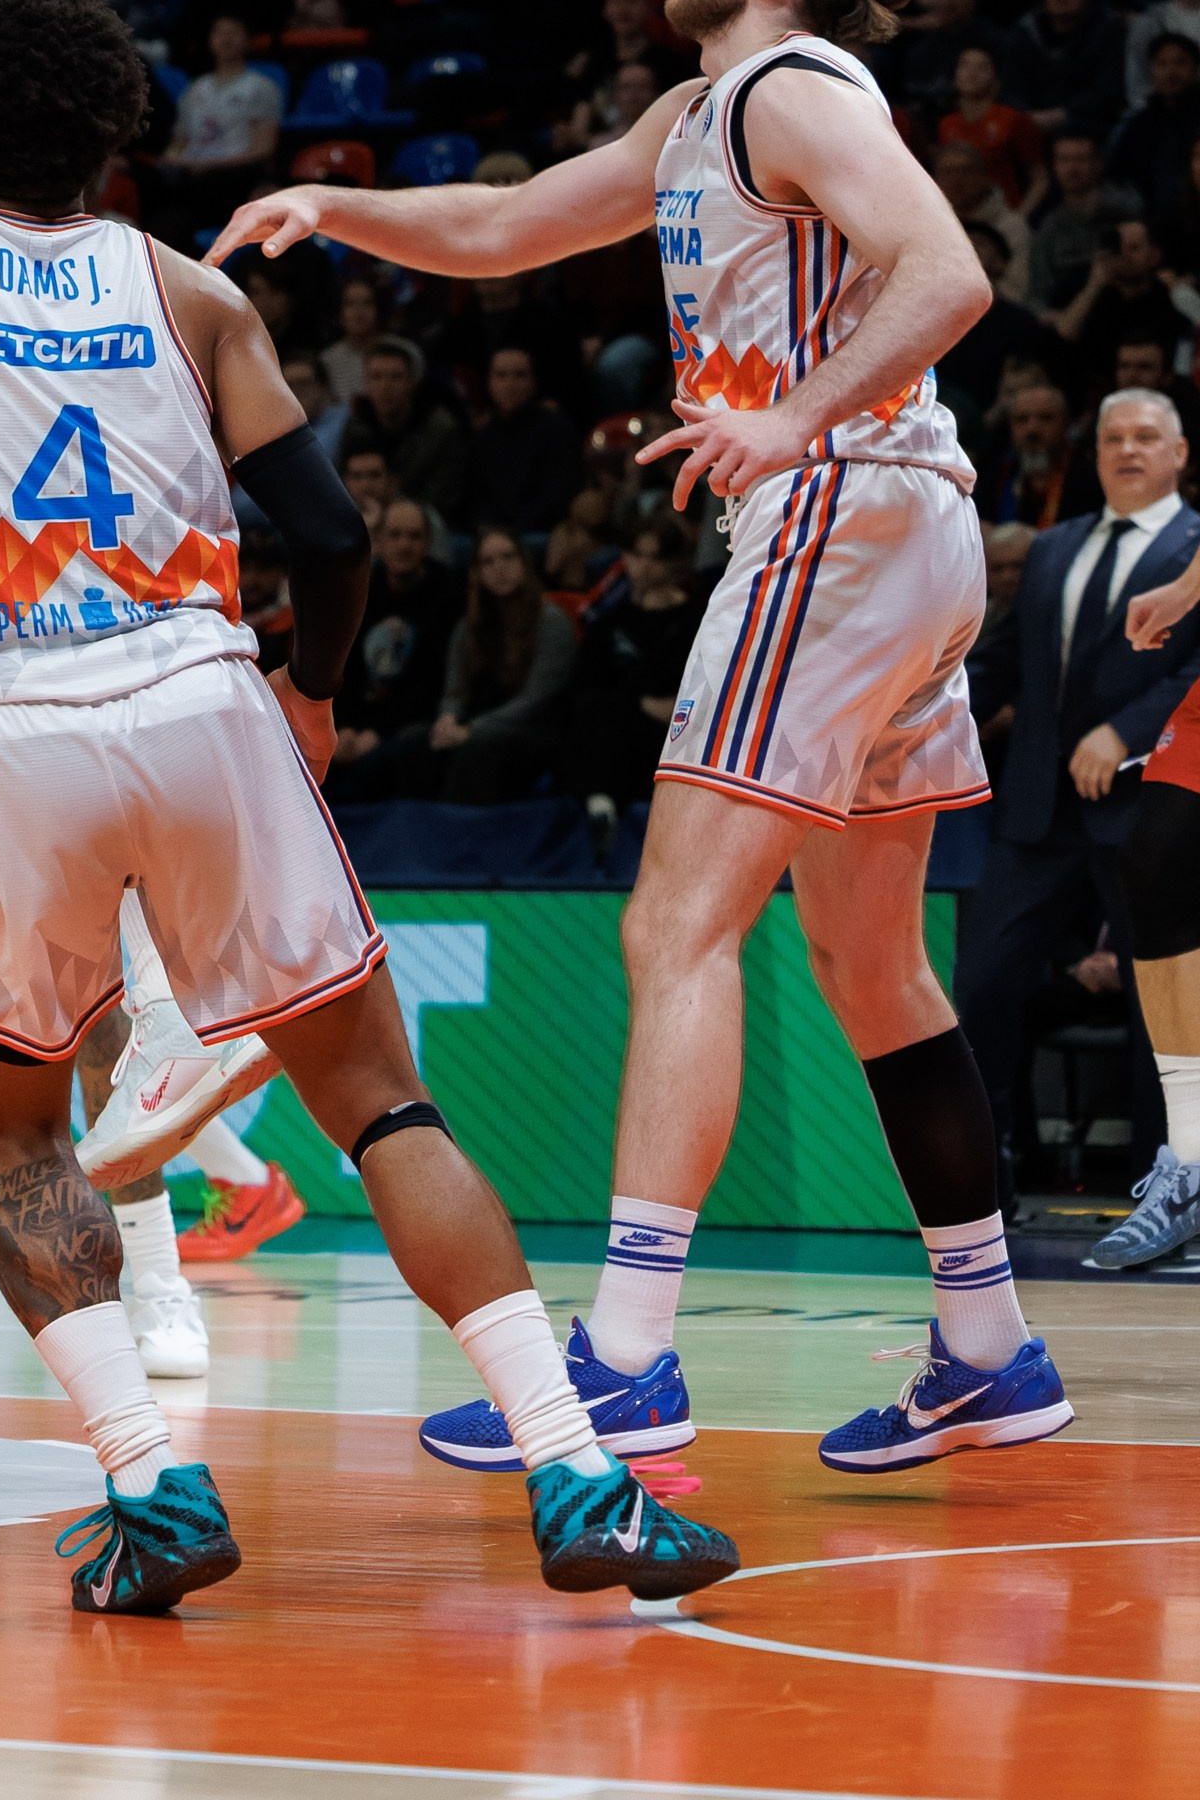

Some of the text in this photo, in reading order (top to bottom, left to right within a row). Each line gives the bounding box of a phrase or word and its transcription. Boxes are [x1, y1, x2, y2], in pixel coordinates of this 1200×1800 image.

[89, 256, 111, 305] J.
[11, 403, 135, 551] 4
[629, 1231, 665, 1244] NIKE
[942, 1253, 973, 1266] NIKE
